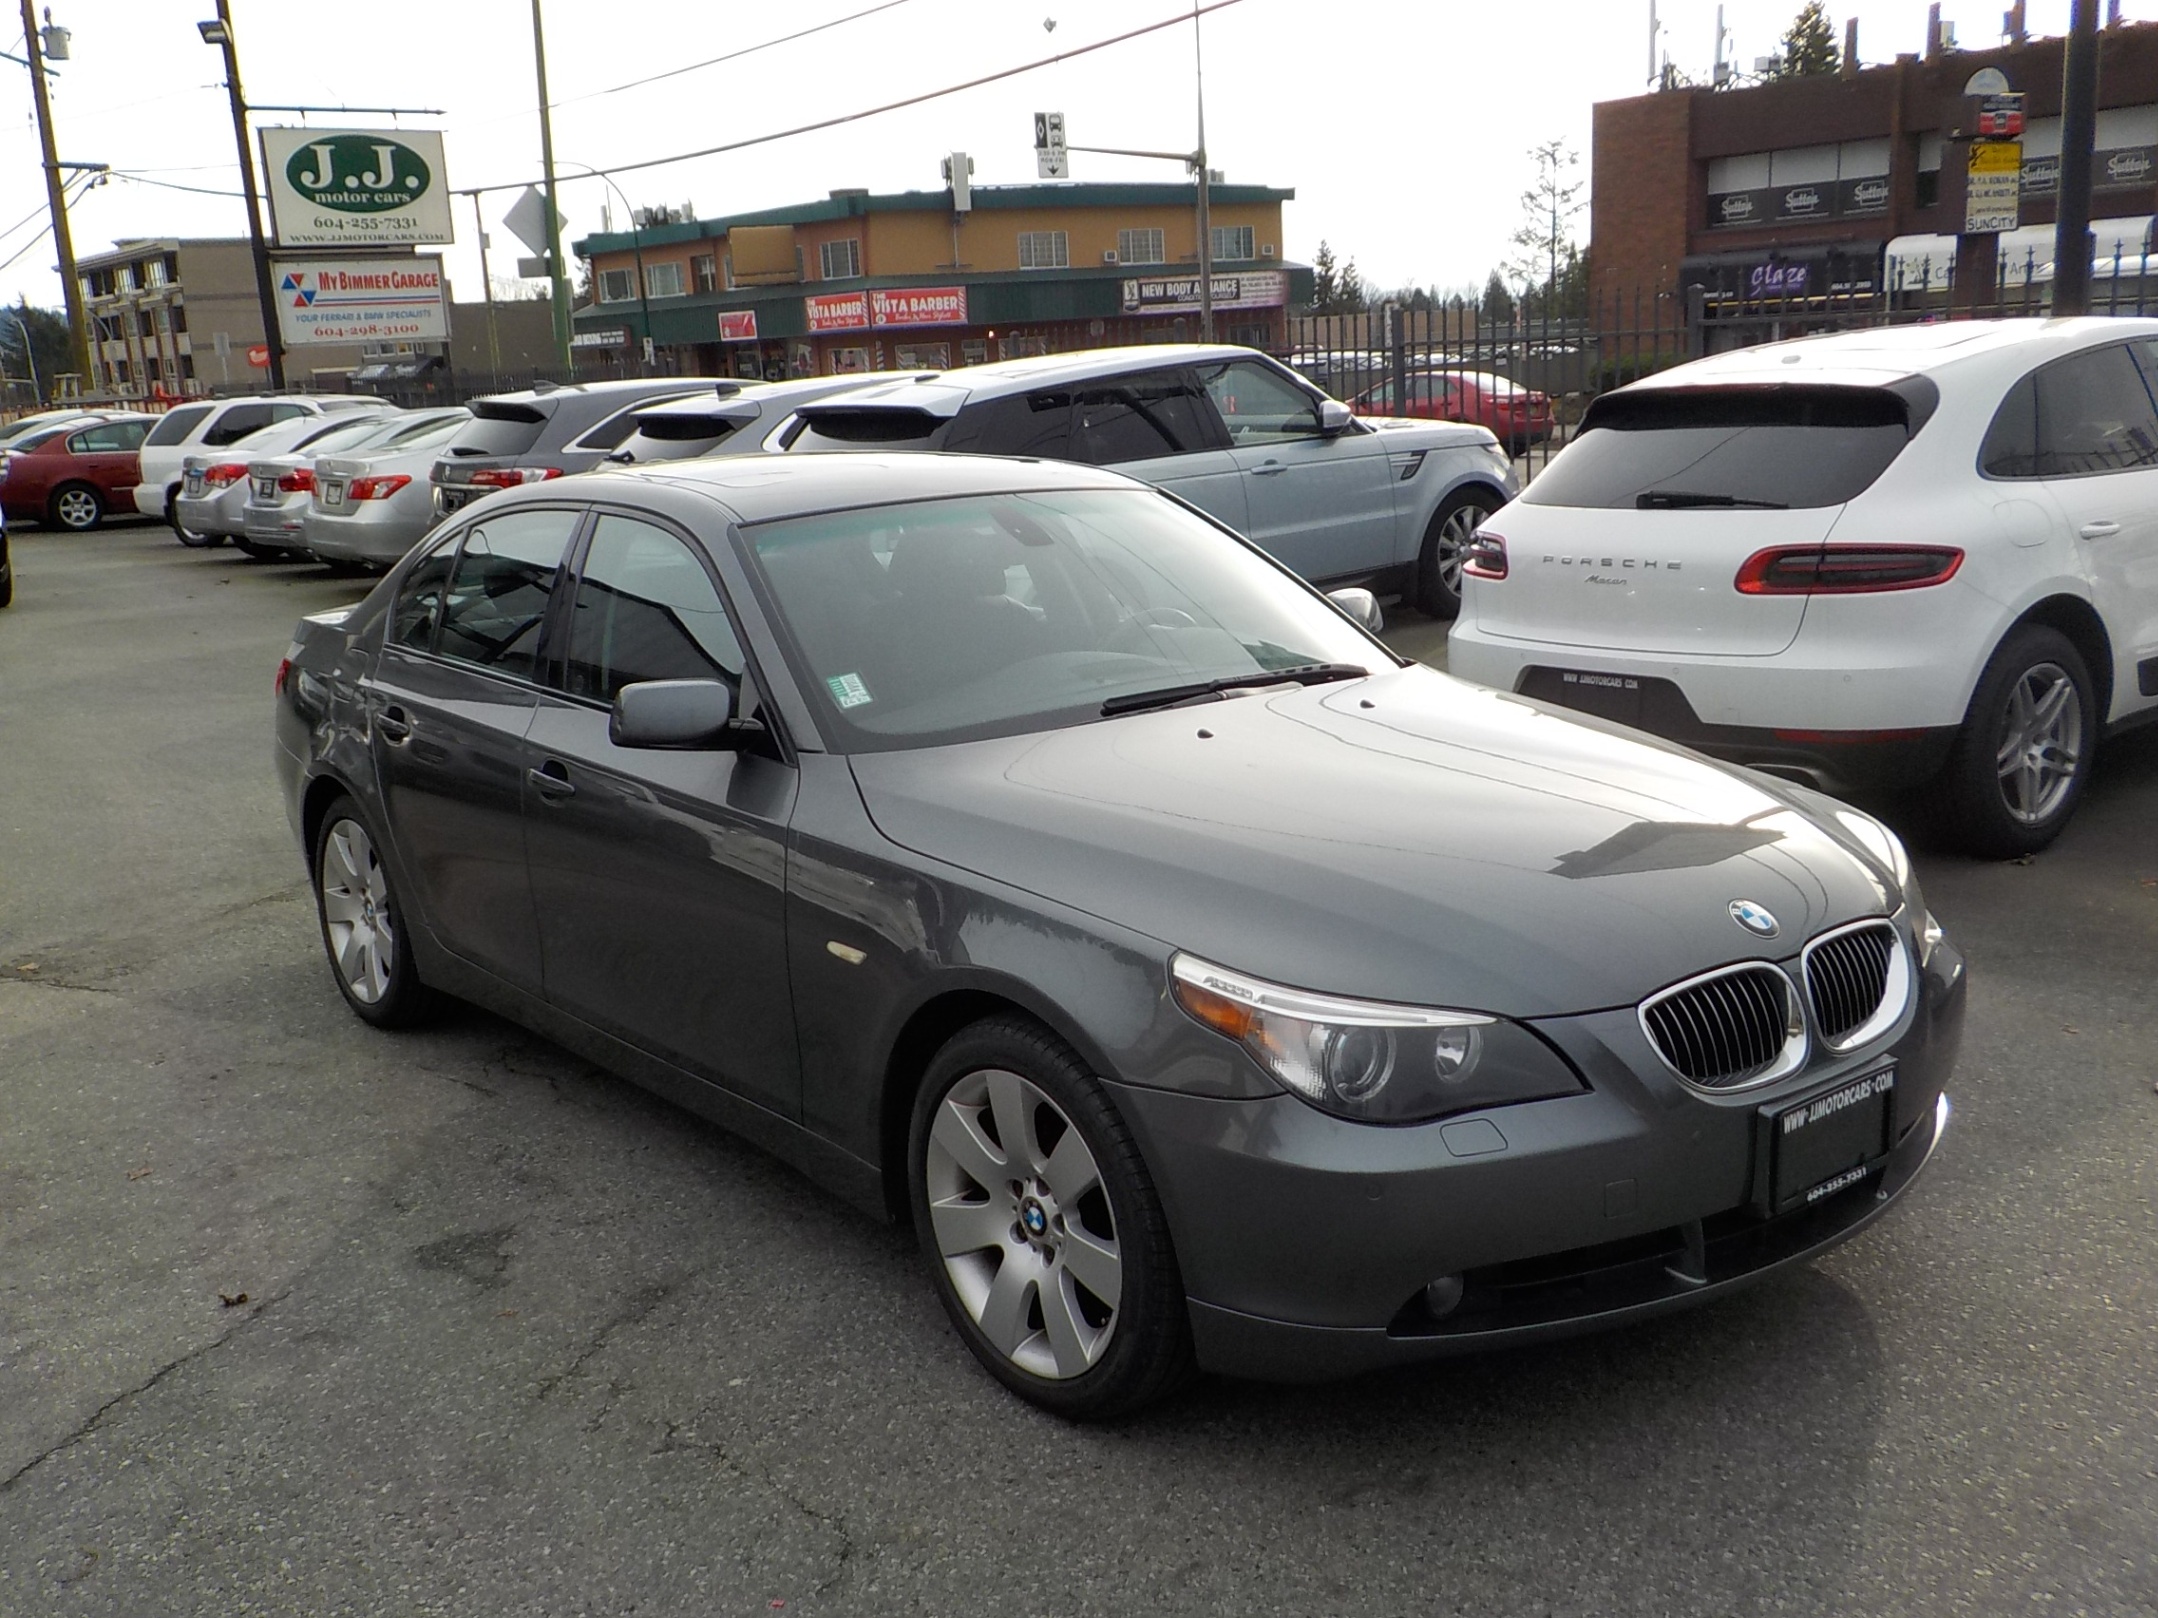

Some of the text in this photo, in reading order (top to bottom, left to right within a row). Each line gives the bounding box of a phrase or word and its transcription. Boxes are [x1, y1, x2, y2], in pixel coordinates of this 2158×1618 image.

[300, 145, 420, 189] J.J.
[2107, 154, 2151, 175] Sutton
[314, 191, 411, 203] motor cars
[313, 216, 418, 230] 604-255-7331
[1142, 284, 1164, 298] NEW
[1166, 282, 1192, 296] BODY
[807, 300, 863, 320] VISTA BARBER
[872, 295, 959, 313] VISTA BARBER
[295, 309, 431, 323] YOUR FERRARI & BMW SPECIALISTS
[314, 324, 419, 337] 604-298-3100
[1543, 555, 1682, 570] PORSCHE
[1584, 574, 1628, 585] Macan
